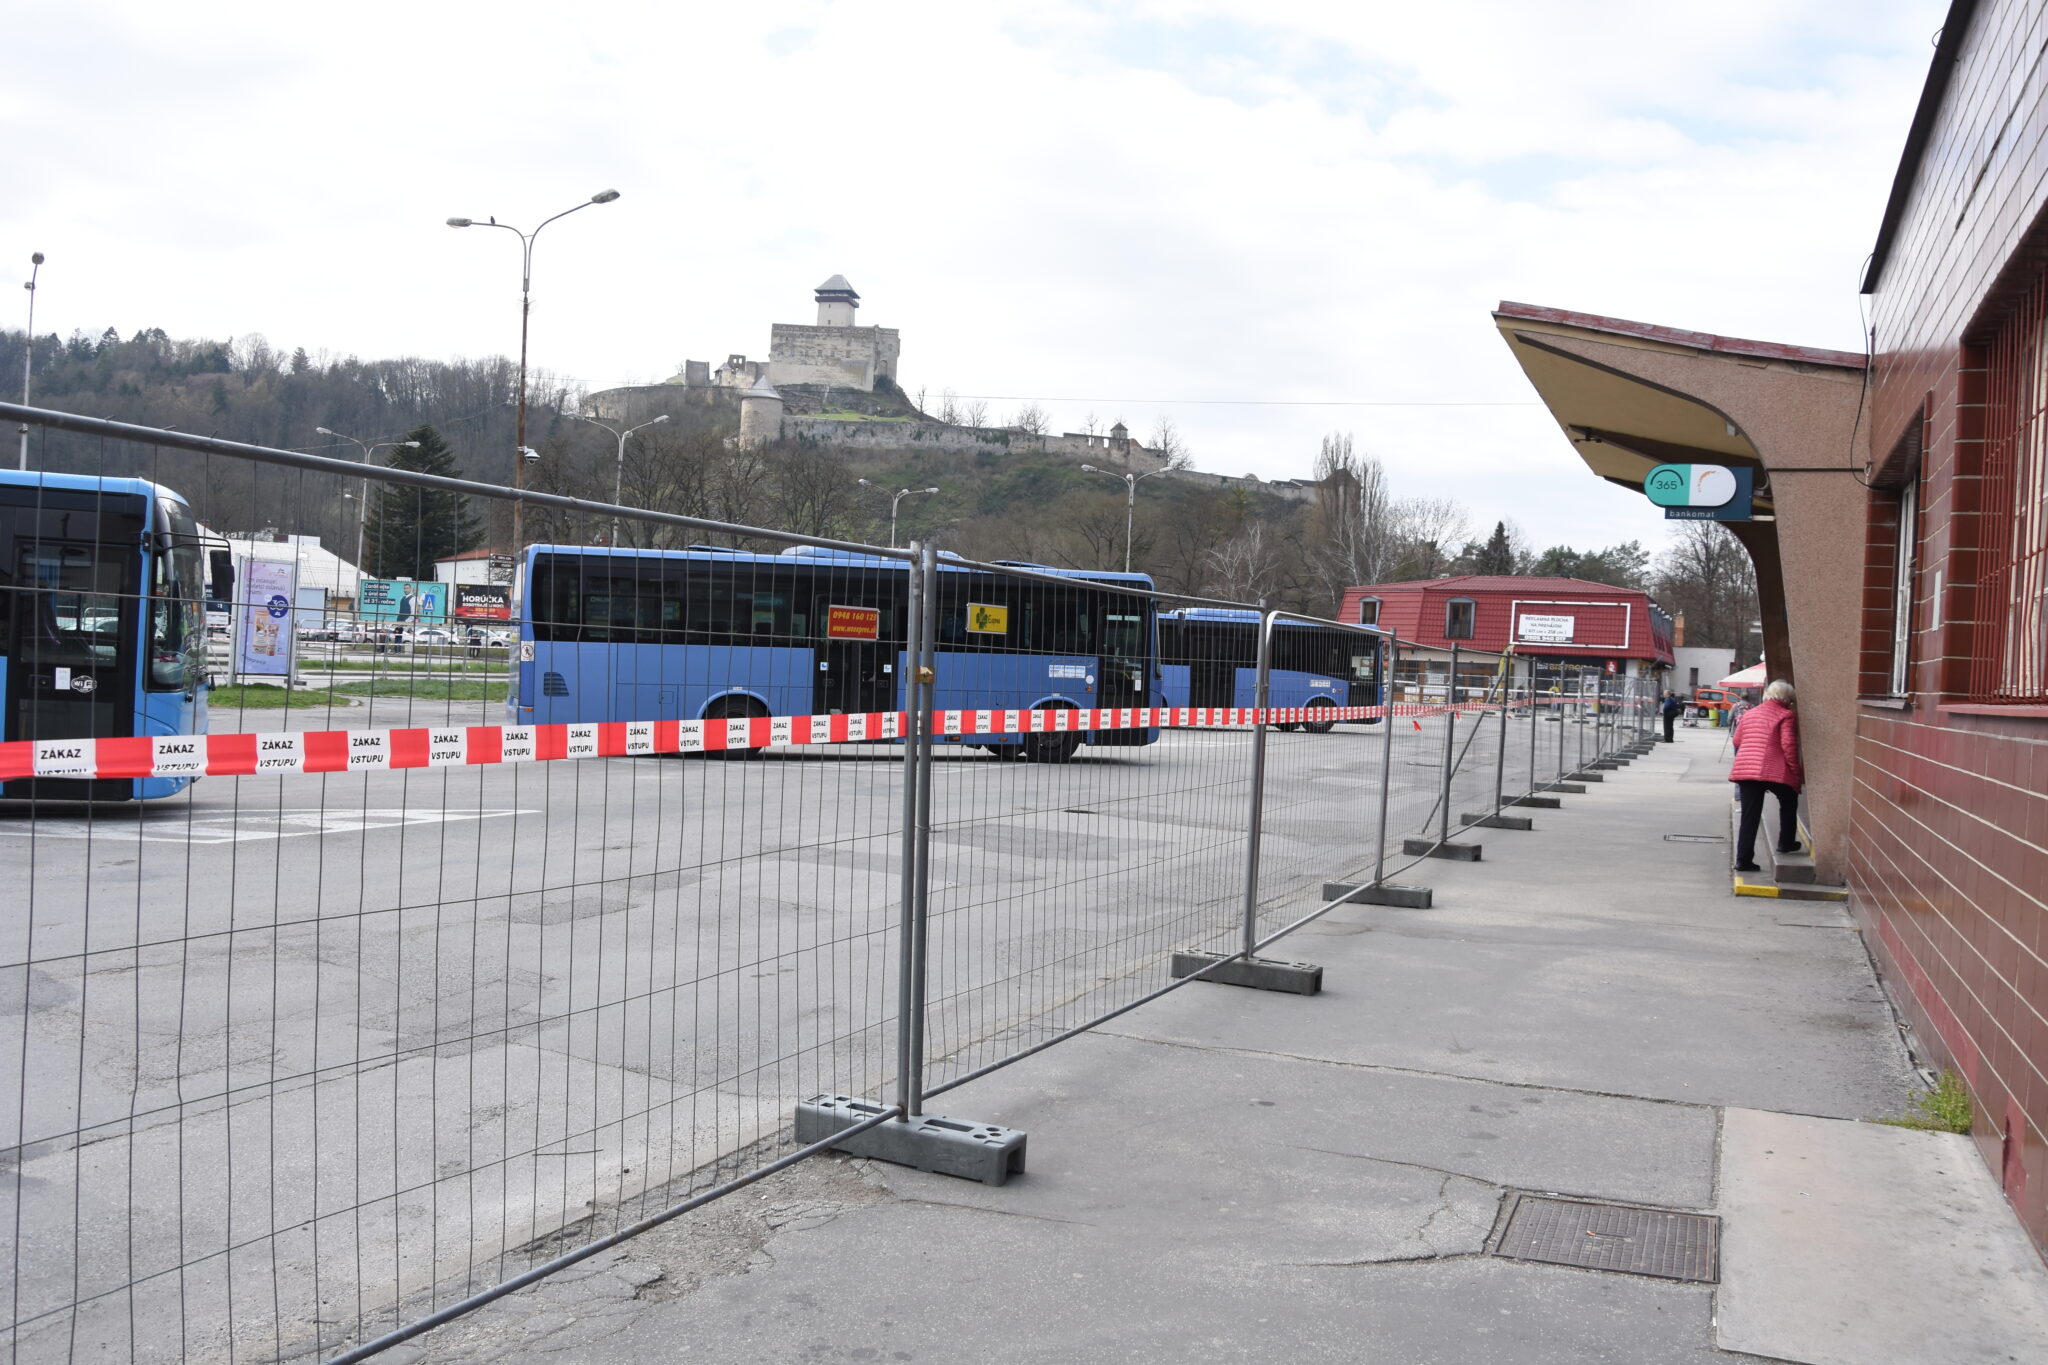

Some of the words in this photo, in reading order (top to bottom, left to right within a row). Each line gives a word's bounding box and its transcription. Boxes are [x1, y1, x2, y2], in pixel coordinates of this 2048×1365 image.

[1656, 480, 1678, 490] 365
[1669, 510, 1715, 518] bankomat
[462, 594, 504, 603] HORÚČKA
[832, 611, 850, 620] 0948
[506, 732, 528, 740] ZÁKAZ
[570, 730, 592, 738] ZÁKAZ
[630, 727, 648, 736] ZÁKAZ
[353, 736, 381, 746] ZÁKAZ
[434, 733, 458, 743] ZÁKAZ
[159, 742, 194, 754] ZÁKAZ
[262, 740, 294, 750] ZÁKAZ
[568, 745, 593, 753] VSTUPU
[40, 747, 82, 760] ZÁKAZ
[432, 751, 461, 760] VSTUPU
[504, 748, 530, 756] VSTUPU
[260, 758, 297, 767] VSTUPU
[350, 754, 384, 763] VSTUPU
[156, 762, 200, 771] VSTUPU
